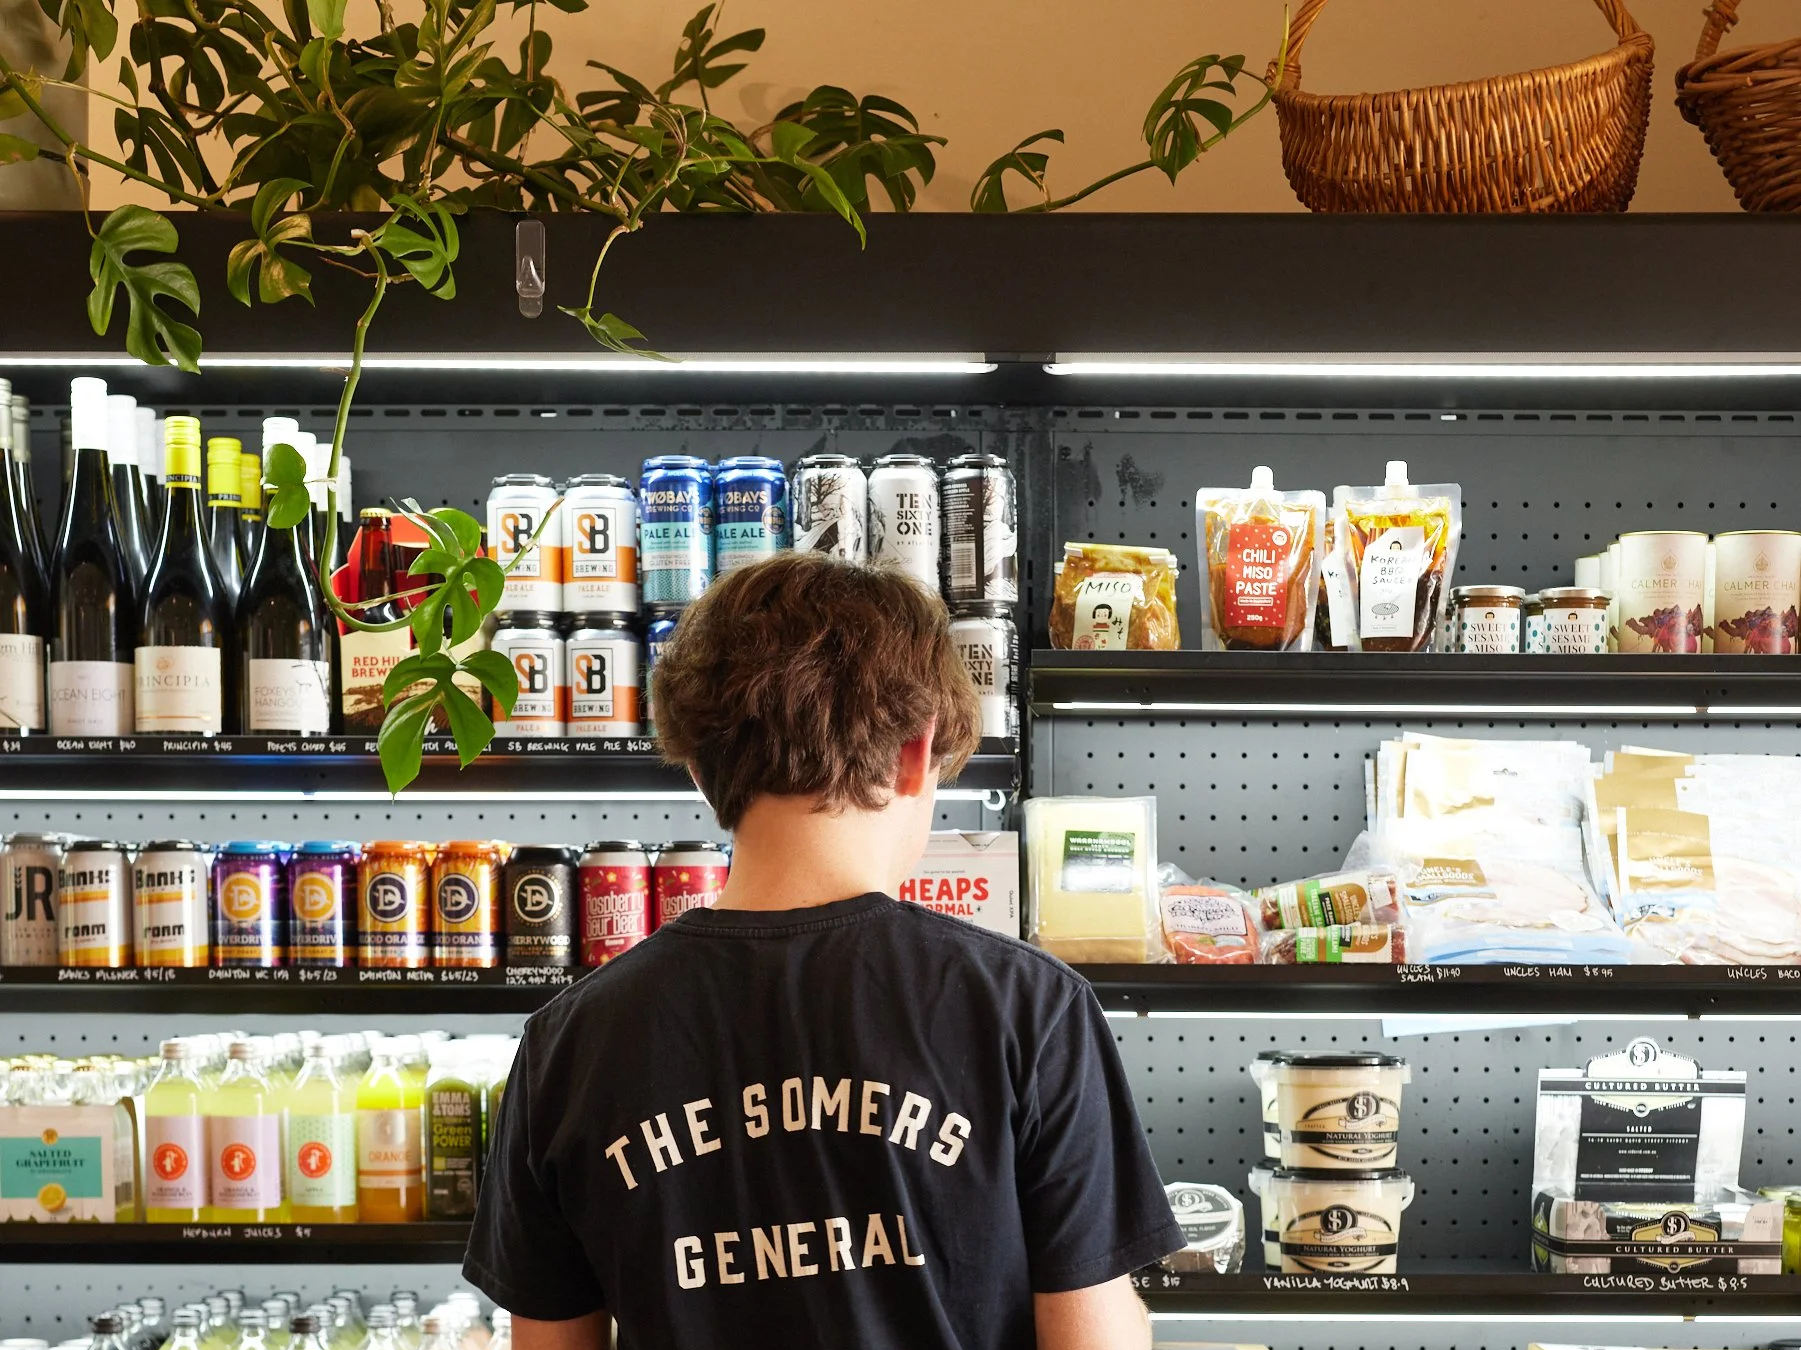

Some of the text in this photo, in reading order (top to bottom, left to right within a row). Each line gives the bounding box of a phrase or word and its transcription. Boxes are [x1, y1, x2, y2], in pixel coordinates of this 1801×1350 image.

[896, 493, 932, 508] TEN
[896, 511, 931, 520] SIXTY
[644, 529, 669, 538] PALE
[741, 528, 765, 538] ALE
[897, 521, 932, 536] ONE
[1243, 549, 1276, 563] CHILI
[1243, 566, 1273, 580] MISO
[1084, 581, 1132, 595] MISO
[1235, 582, 1278, 596] PASTE
[1631, 579, 1677, 589] CALMER
[1724, 581, 1769, 591] CALMER
[1470, 623, 1507, 632] SWEET
[957, 644, 993, 659] TEN
[1475, 645, 1503, 653] MISO
[1558, 646, 1586, 654] MISO
[353, 657, 378, 666] RED
[971, 672, 993, 685] NE
[57, 741, 84, 750] OCEAN
[508, 741, 522, 750] SB
[900, 878, 989, 901] HEAPS
[586, 890, 644, 914] Raspberry
[58, 969, 90, 980] BANKS
[1504, 967, 1572, 977] UNCLES HAM
[1728, 967, 1767, 979] UNCLES
[1585, 1082, 1700, 1091] CULTURED BUTTER
[432, 1092, 471, 1104] EMMA
[433, 1125, 472, 1134] Green
[605, 1075, 972, 1190] THE SOMERS
[433, 1136, 472, 1147] POWER
[30, 1150, 72, 1158] SALTED
[16, 1159, 85, 1167] GRAPEFRUIT
[673, 1213, 926, 1290] GENERAL
[1303, 1245, 1377, 1253] NATURAL YOGHURT
[1688, 1246, 1734, 1254] BUTTER
[1263, 1277, 1322, 1289] VANILLA
[1325, 1277, 1378, 1289] YOGHURT
[1583, 1275, 1654, 1289] CULTURED
